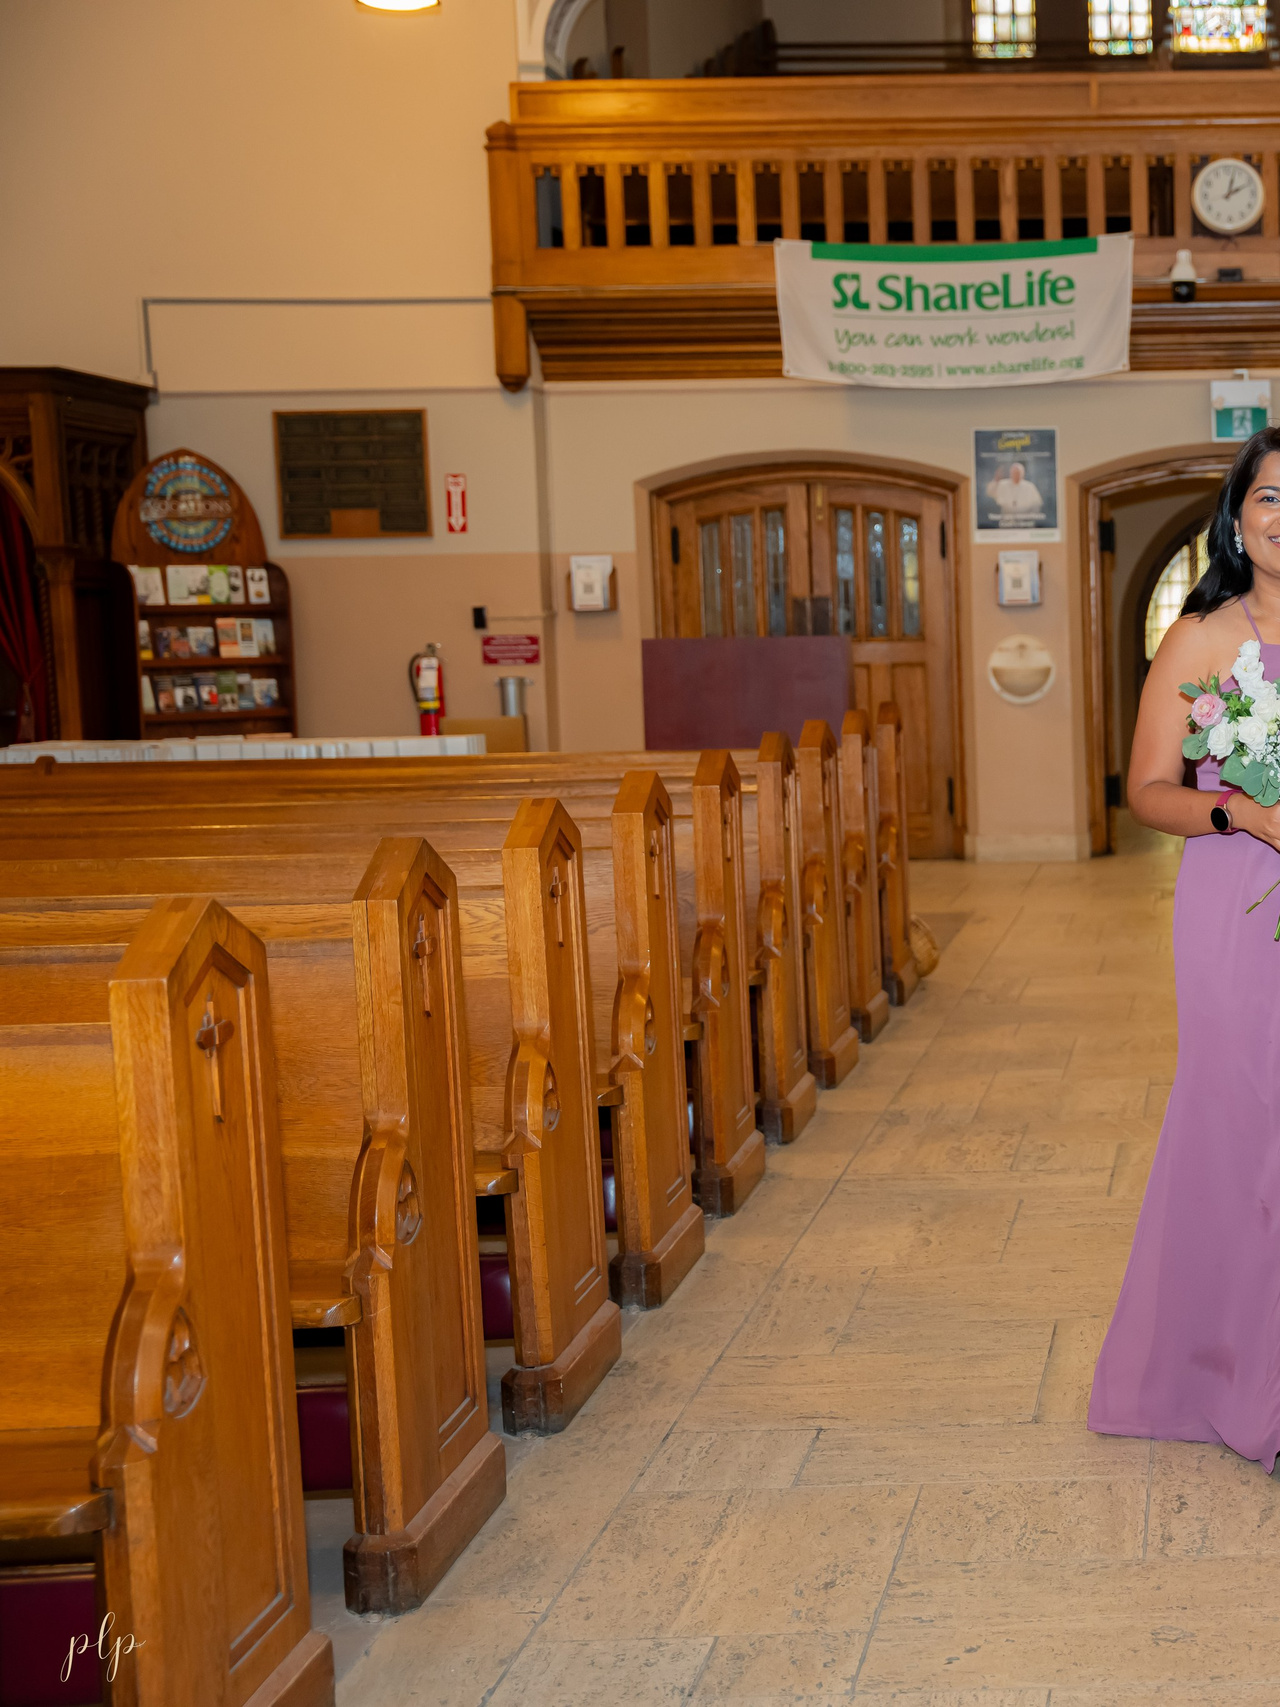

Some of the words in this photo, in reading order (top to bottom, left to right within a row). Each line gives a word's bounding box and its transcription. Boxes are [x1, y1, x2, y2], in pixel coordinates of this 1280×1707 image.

[877, 268, 1075, 311] ShareLife
[834, 328, 877, 354] You
[883, 332, 923, 348] can
[929, 325, 979, 348] work
[985, 319, 1076, 346] wonders!
[945, 356, 1084, 376] www.sharelife.org
